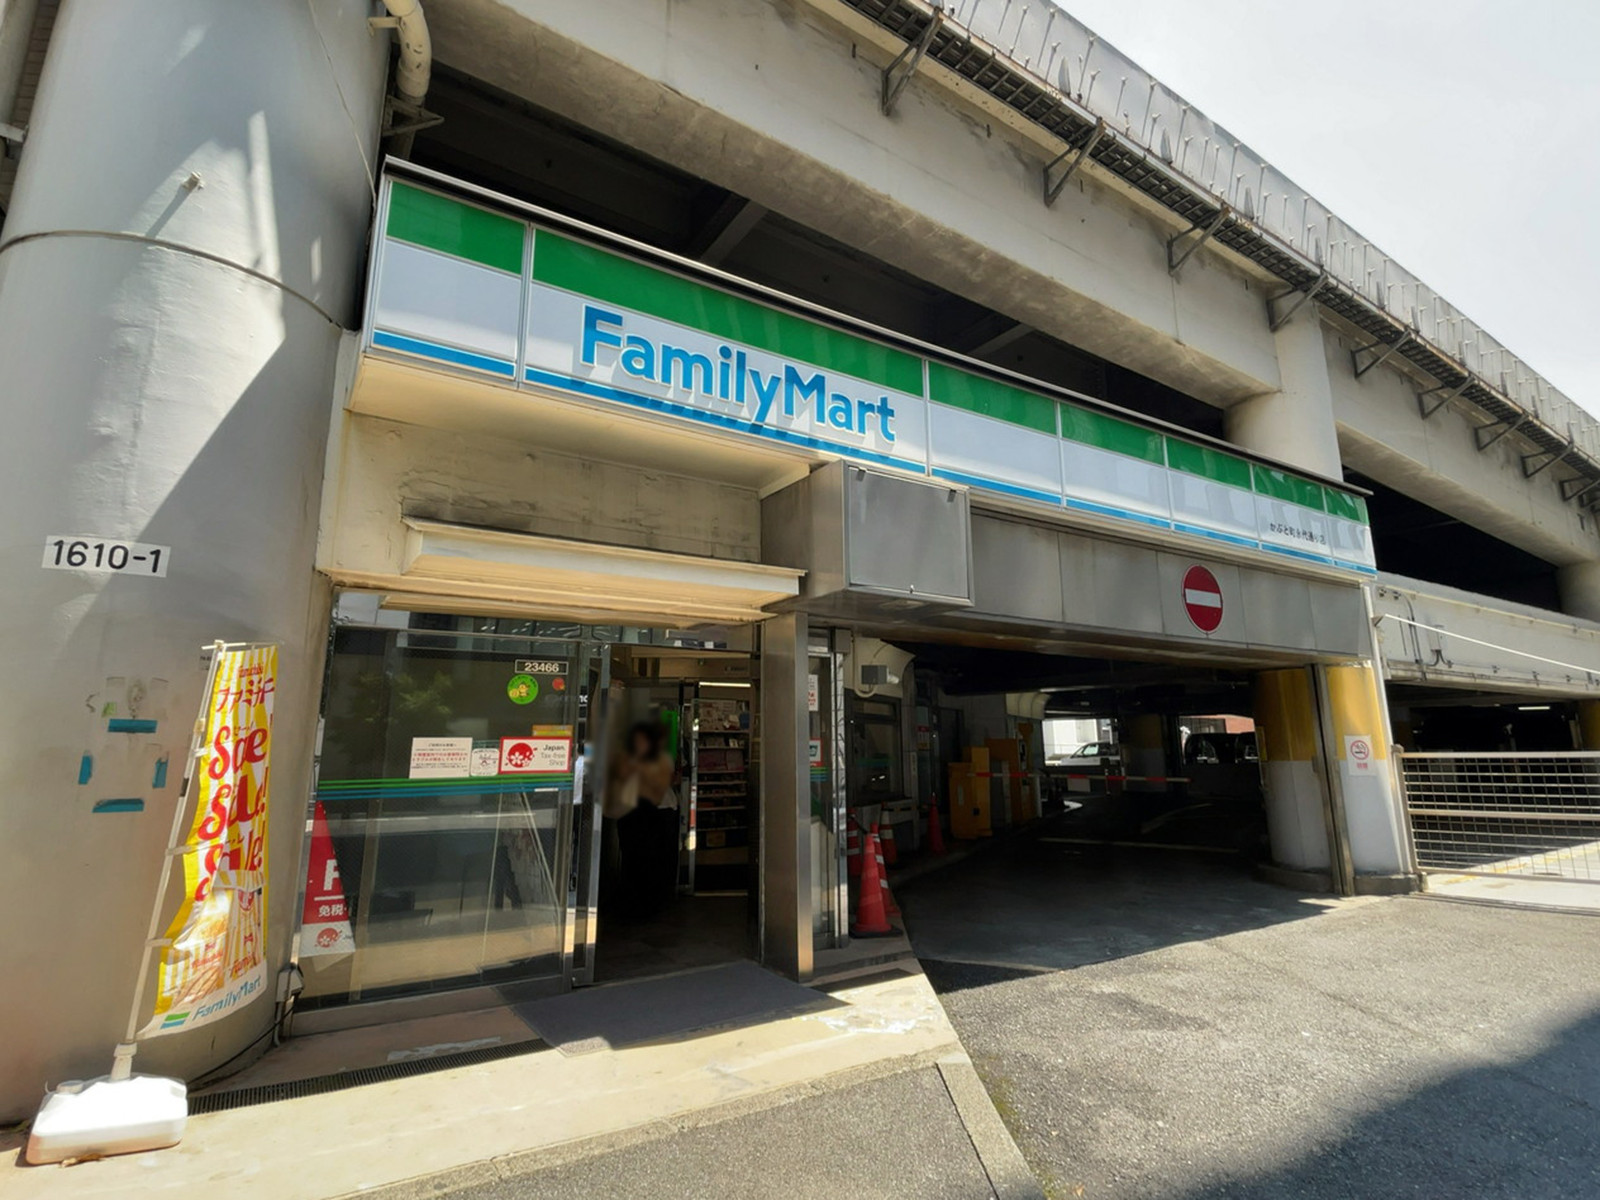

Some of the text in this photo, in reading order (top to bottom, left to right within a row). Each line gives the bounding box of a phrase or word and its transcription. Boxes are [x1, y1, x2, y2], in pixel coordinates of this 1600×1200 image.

[581, 302, 897, 444] FamilyMart
[52, 539, 162, 574] 1610-1
[524, 662, 560, 673] 23466
